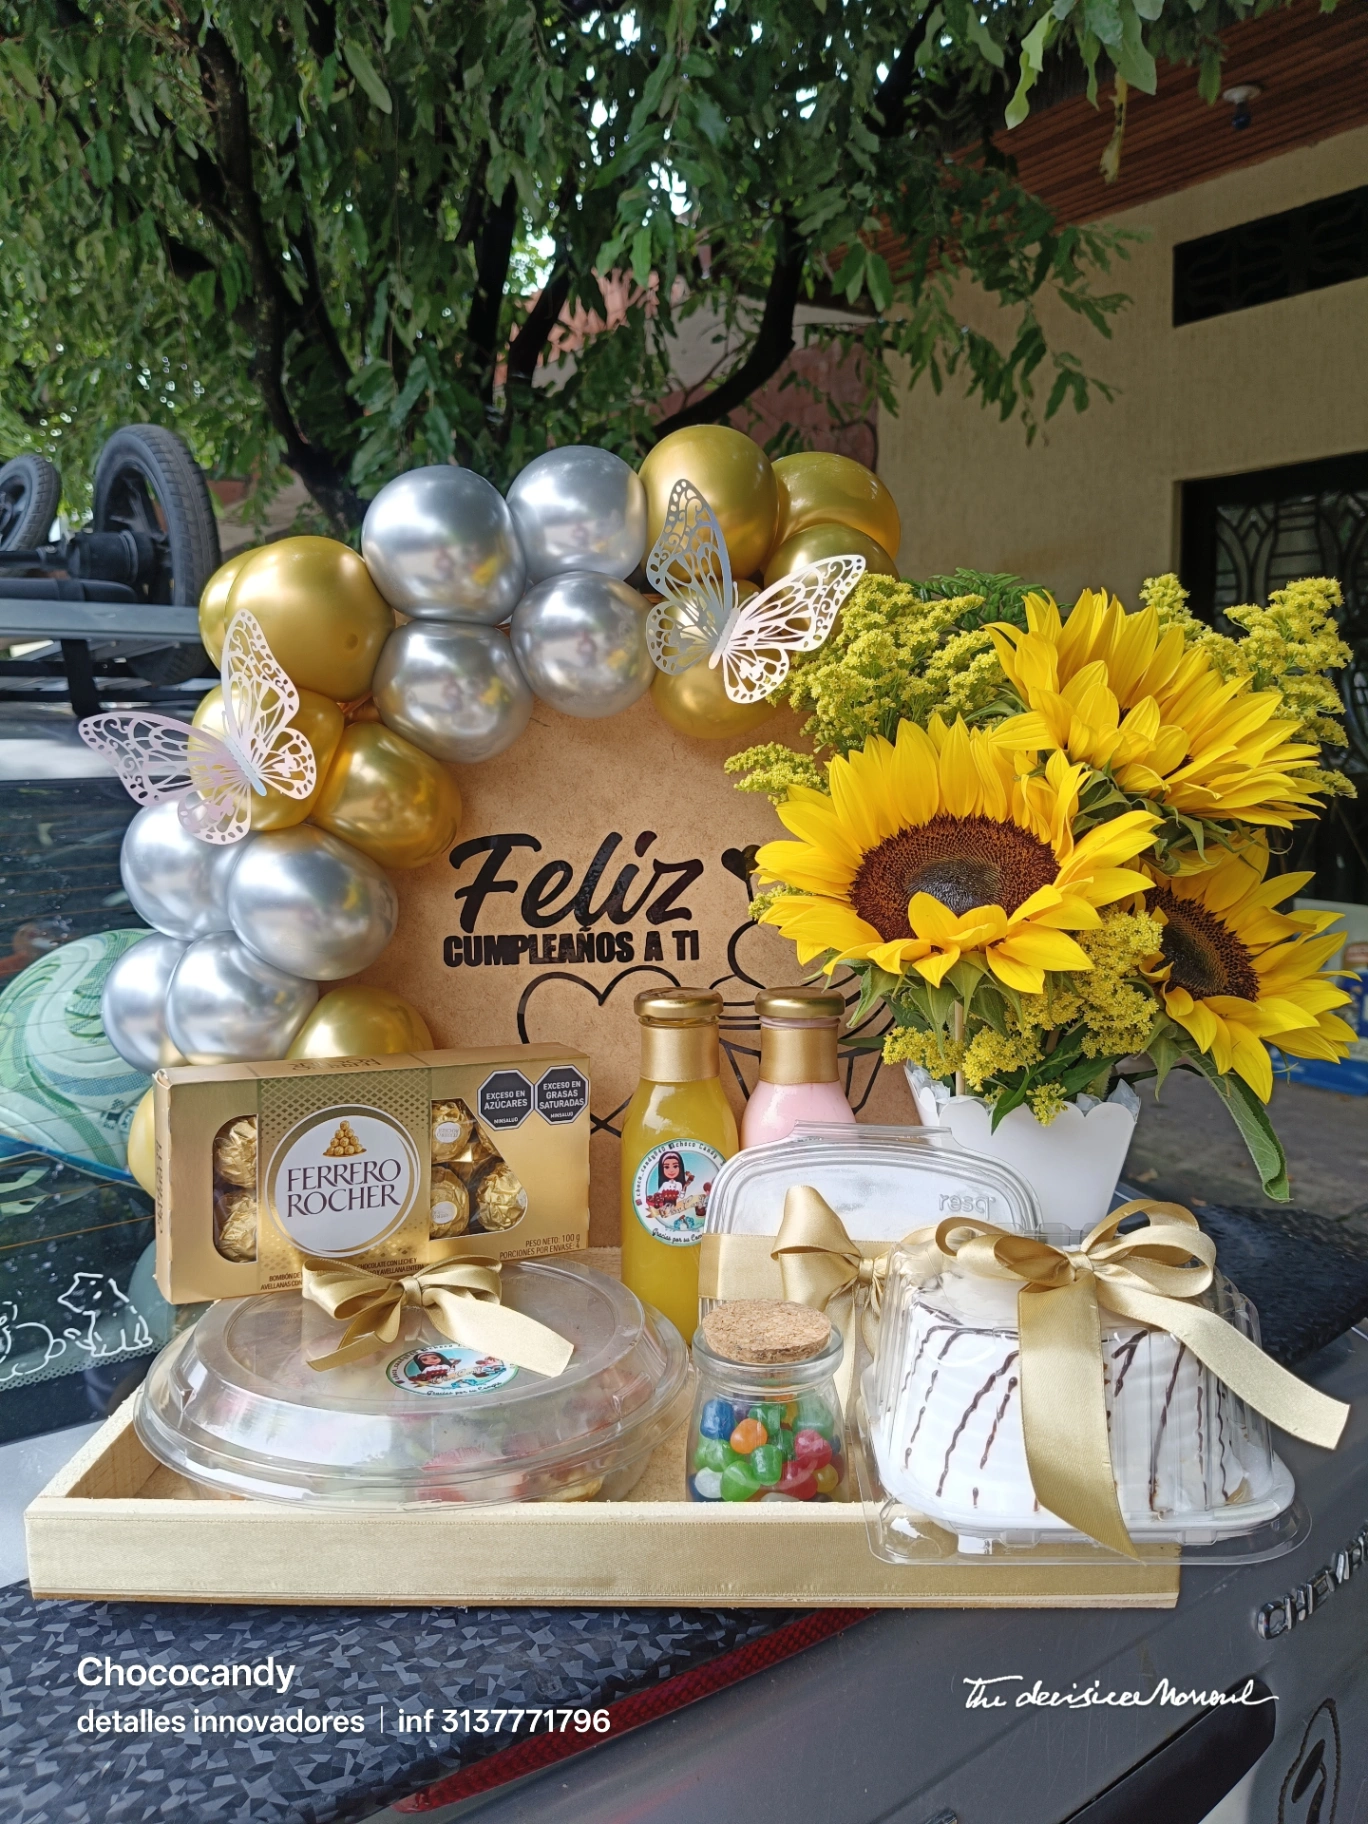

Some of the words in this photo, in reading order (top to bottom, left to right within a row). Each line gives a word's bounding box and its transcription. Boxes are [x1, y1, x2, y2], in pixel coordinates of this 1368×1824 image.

[449, 830, 704, 933] Feliz
[443, 926, 634, 967] CUMPLEAÑOS
[644, 931, 663, 961] A
[672, 930, 699, 960] TI
[543, 1081, 569, 1090] EXCESO
[486, 1091, 514, 1100] EXCESO
[516, 1090, 525, 1098] EN
[545, 1089, 578, 1099] GRASAS
[484, 1098, 528, 1111] AZÚCARES
[539, 1098, 584, 1110] SATURADAS
[287, 1159, 402, 1192] FERRERO
[287, 1184, 401, 1217] ROCHER
[525, 1239, 541, 1247] PESO
[562, 1233, 574, 1242] 100
[500, 1248, 535, 1258] PORCIONES
[536, 1246, 549, 1254] POR
